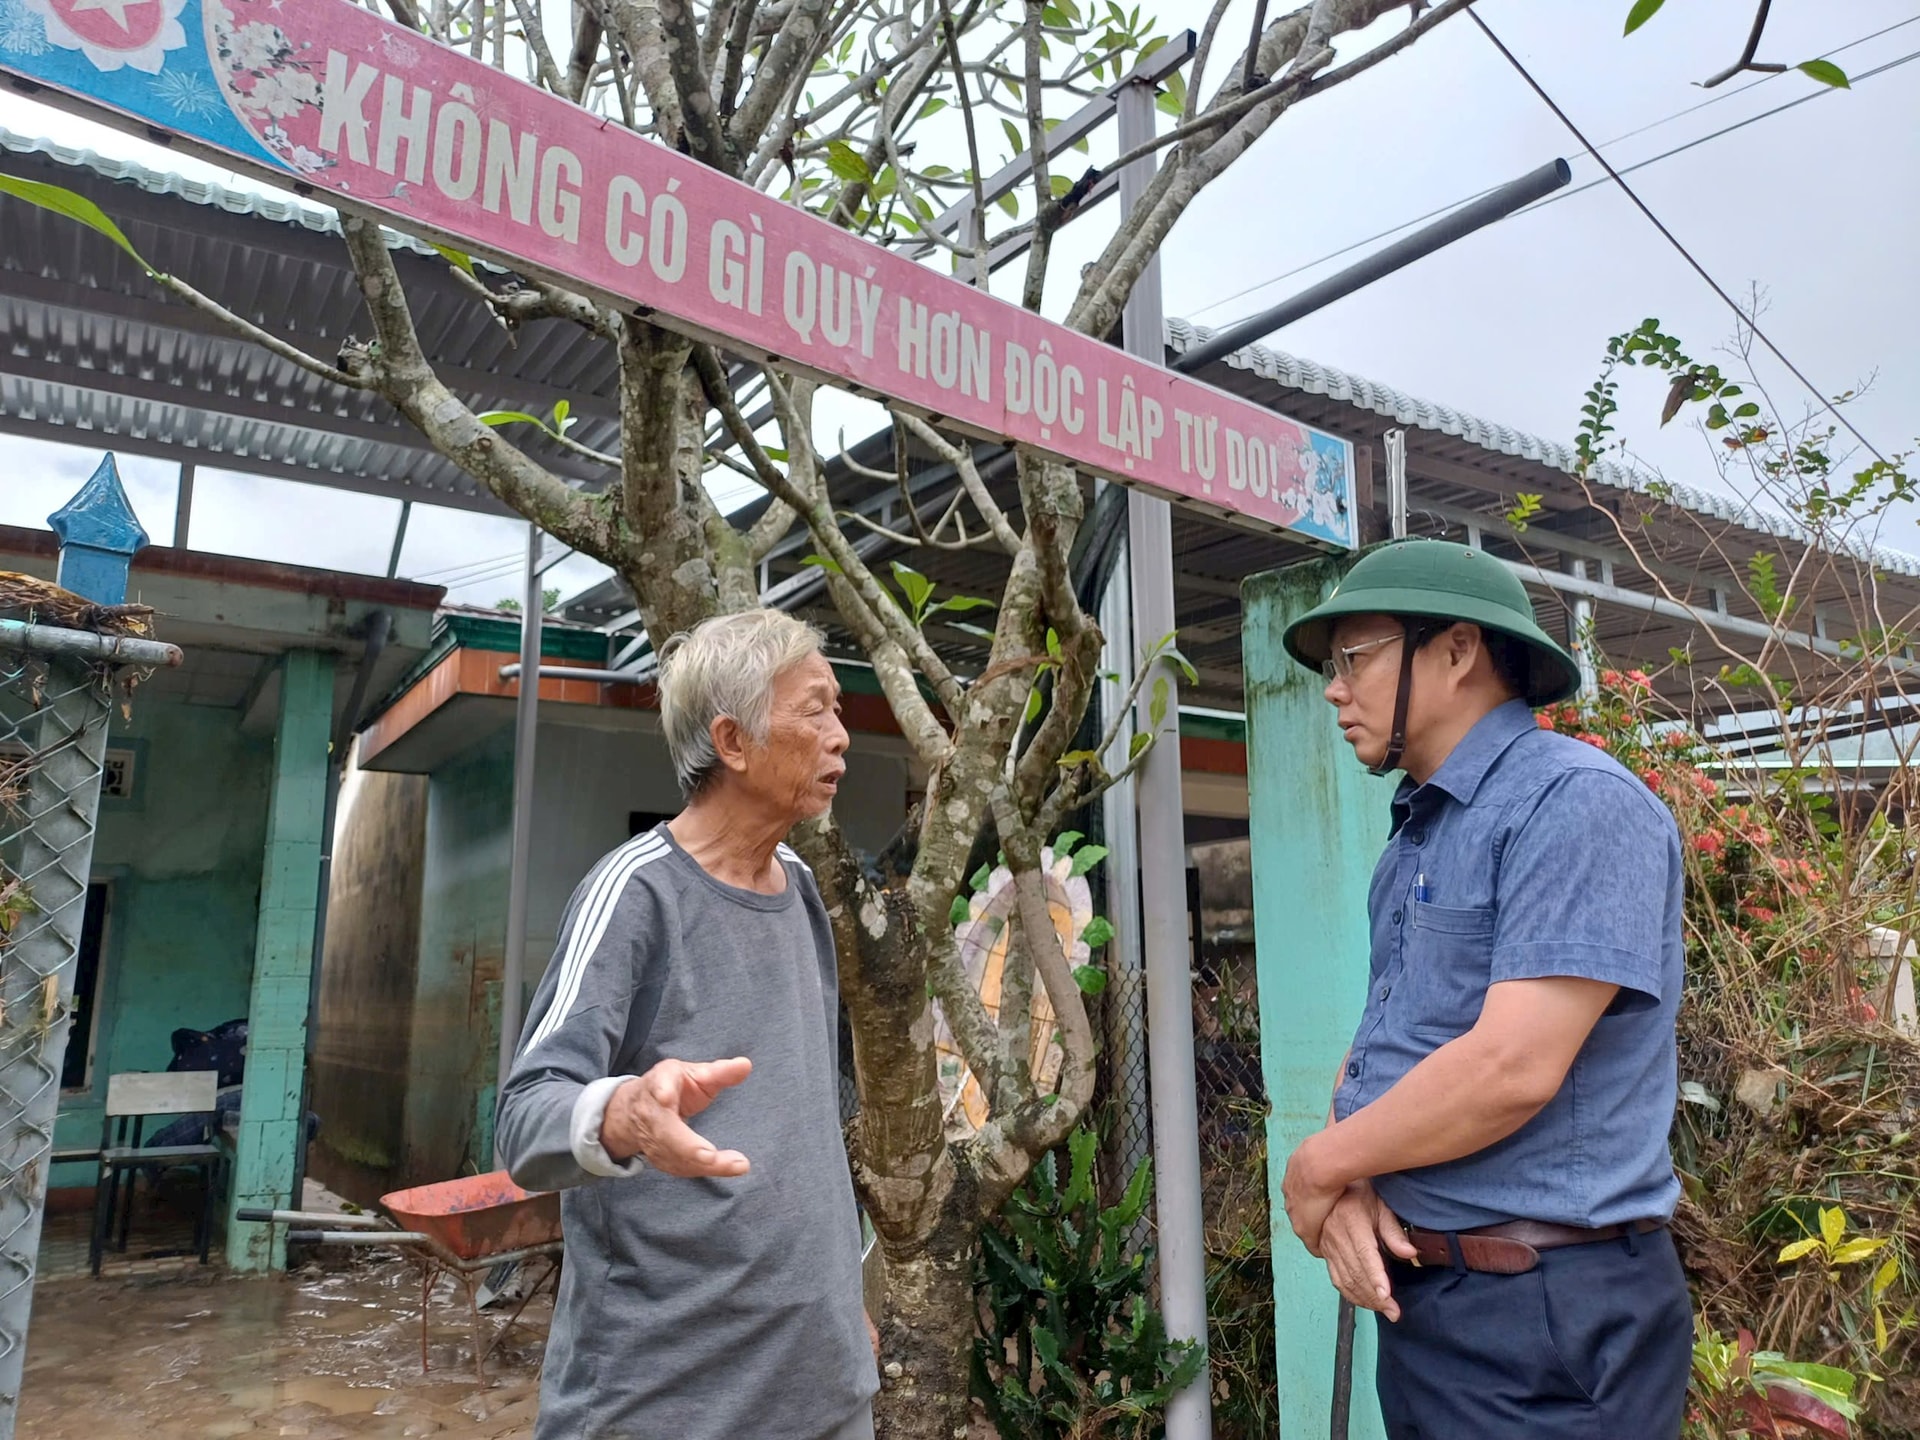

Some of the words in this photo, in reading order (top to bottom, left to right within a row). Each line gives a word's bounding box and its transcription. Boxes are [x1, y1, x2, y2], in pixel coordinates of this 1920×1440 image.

[318, 48, 583, 245] KHÔNG
[605, 177, 688, 284] CÓ
[708, 212, 765, 317] GÌ
[783, 250, 883, 359] QUÝ
[898, 296, 991, 403] HƠN
[1003, 339, 1086, 441] ĐỘC
[1097, 374, 1165, 470] LẬP
[1174, 408, 1219, 494] TỰ
[1225, 427, 1279, 504] DO!
